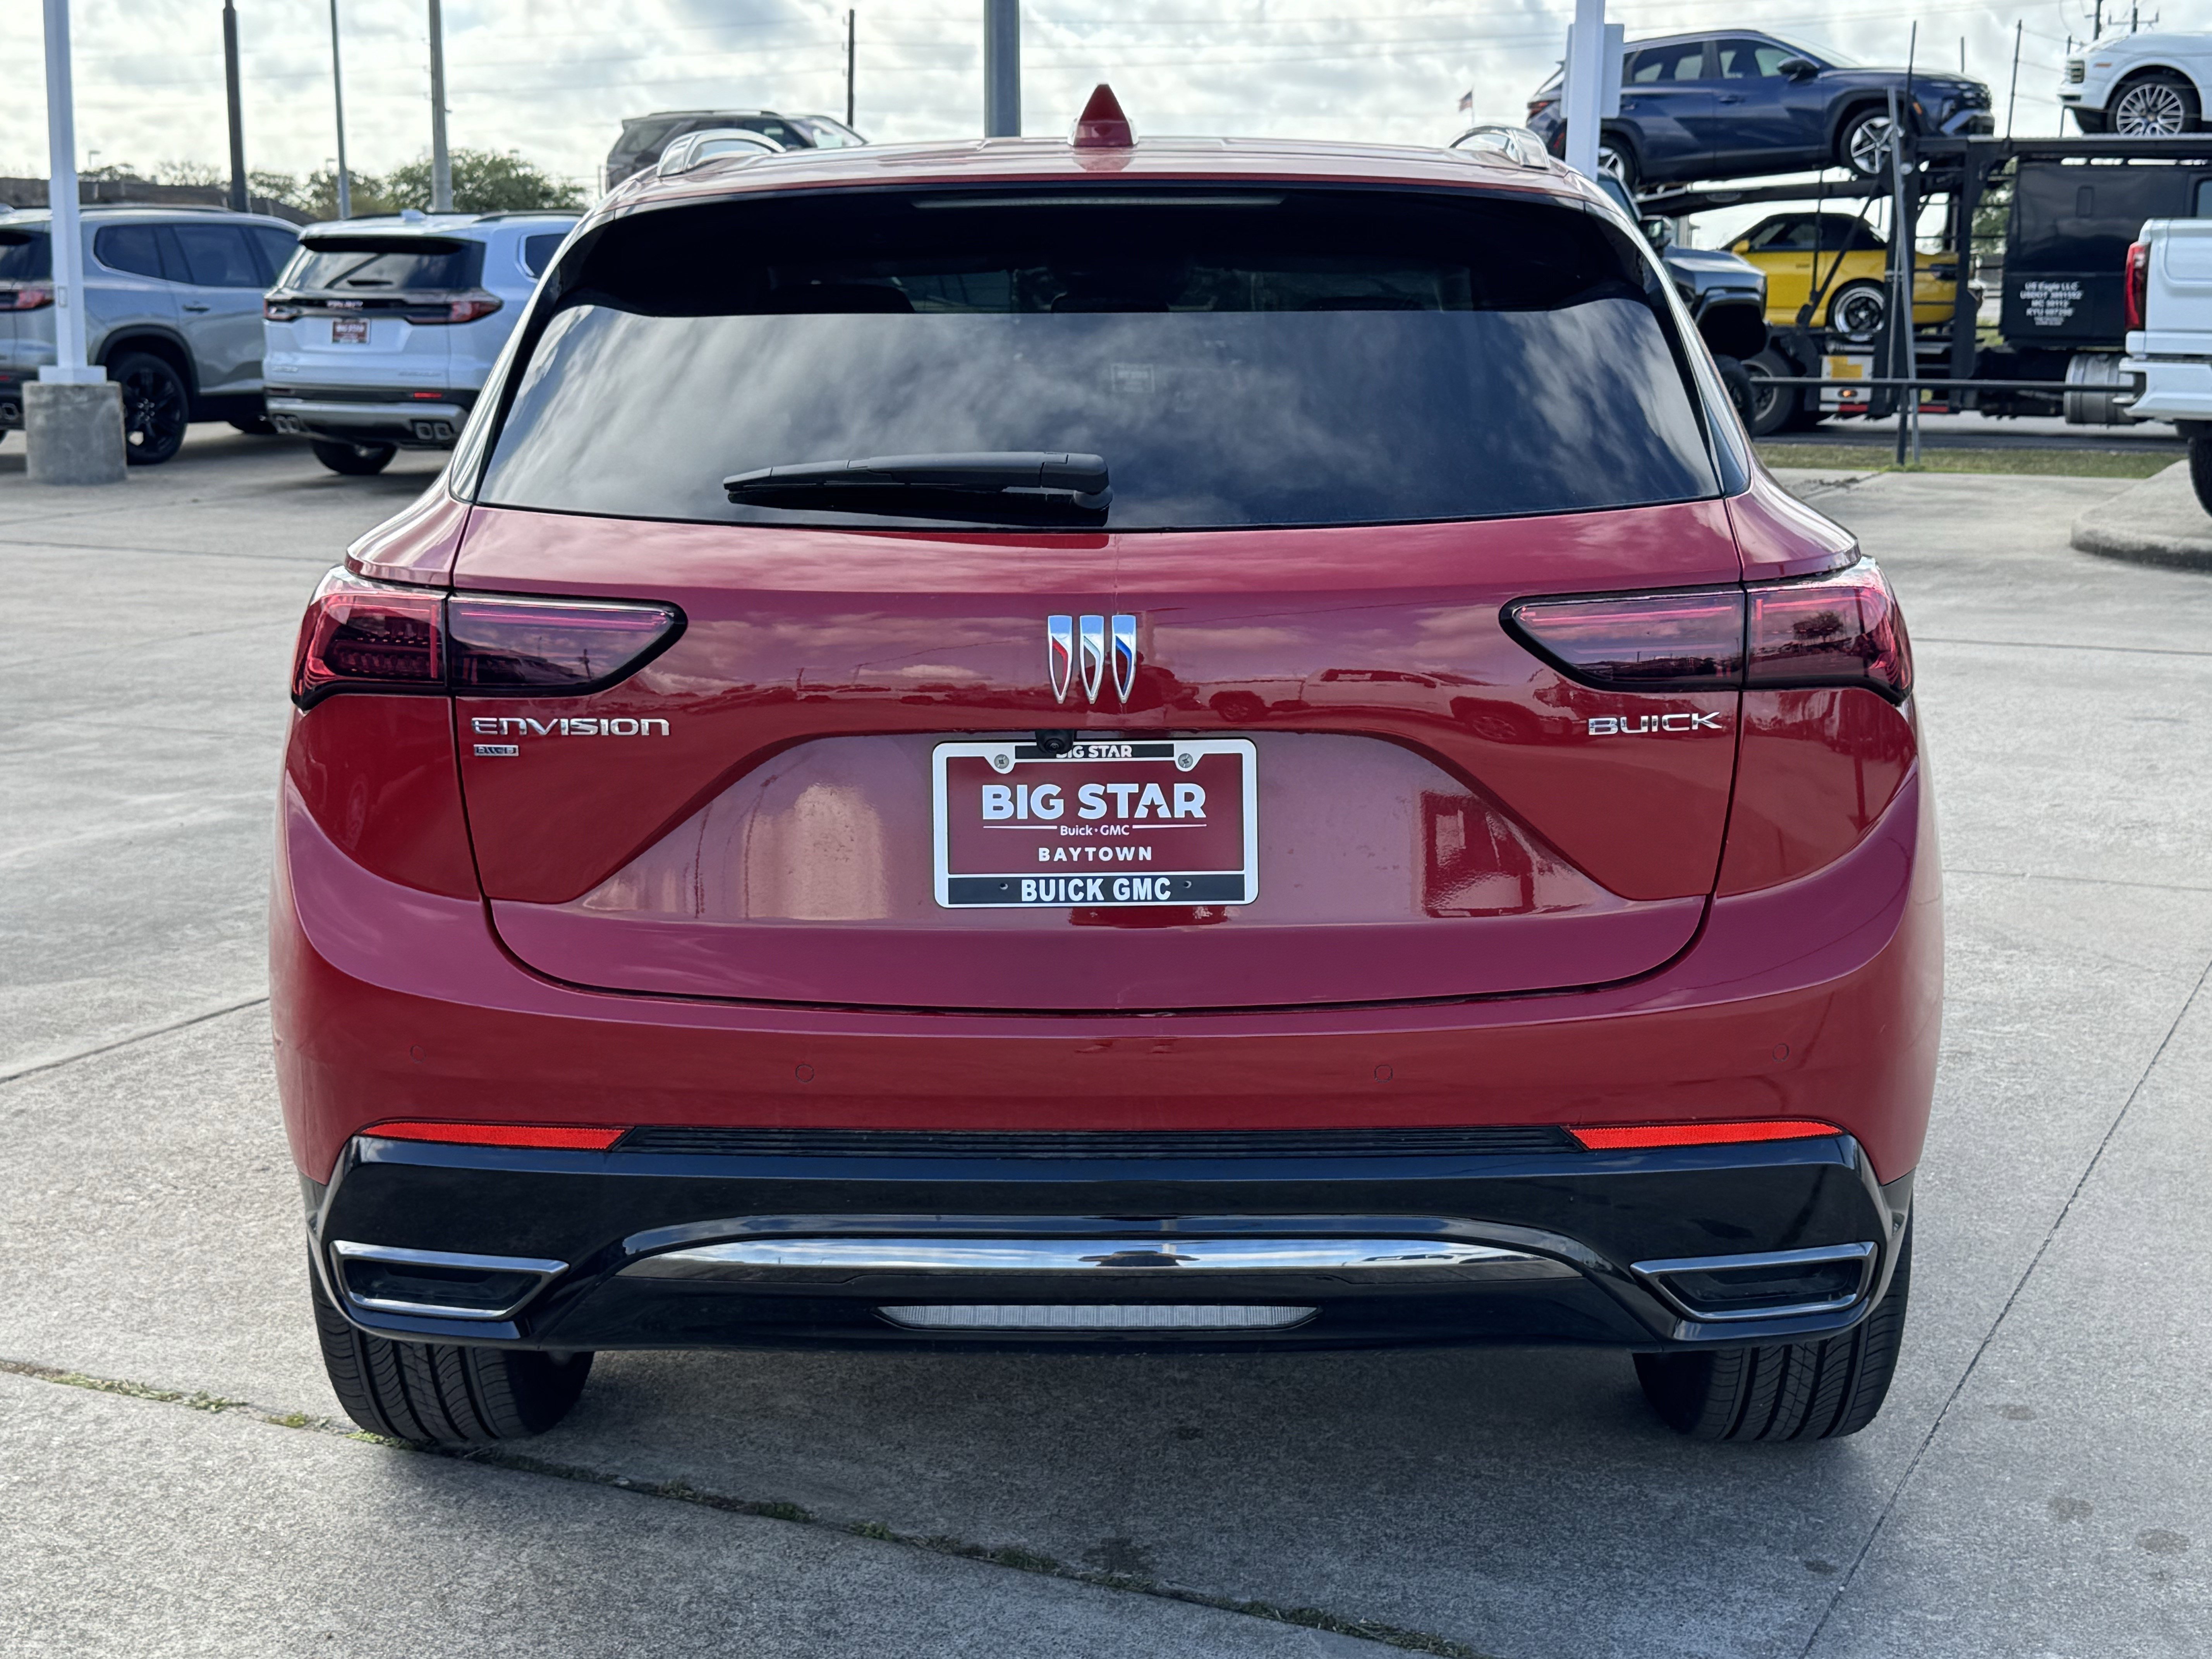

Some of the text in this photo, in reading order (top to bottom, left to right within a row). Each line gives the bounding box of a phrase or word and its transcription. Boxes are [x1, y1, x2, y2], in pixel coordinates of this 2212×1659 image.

[471, 717, 670, 736] ENVISION
[1589, 712, 1723, 735] BUICK
[1088, 745, 1132, 758] STAR
[982, 783, 1206, 820] BIG STAR
[1038, 846, 1152, 862] BAYTOWN
[1021, 877, 1171, 902] BUICK GMC
